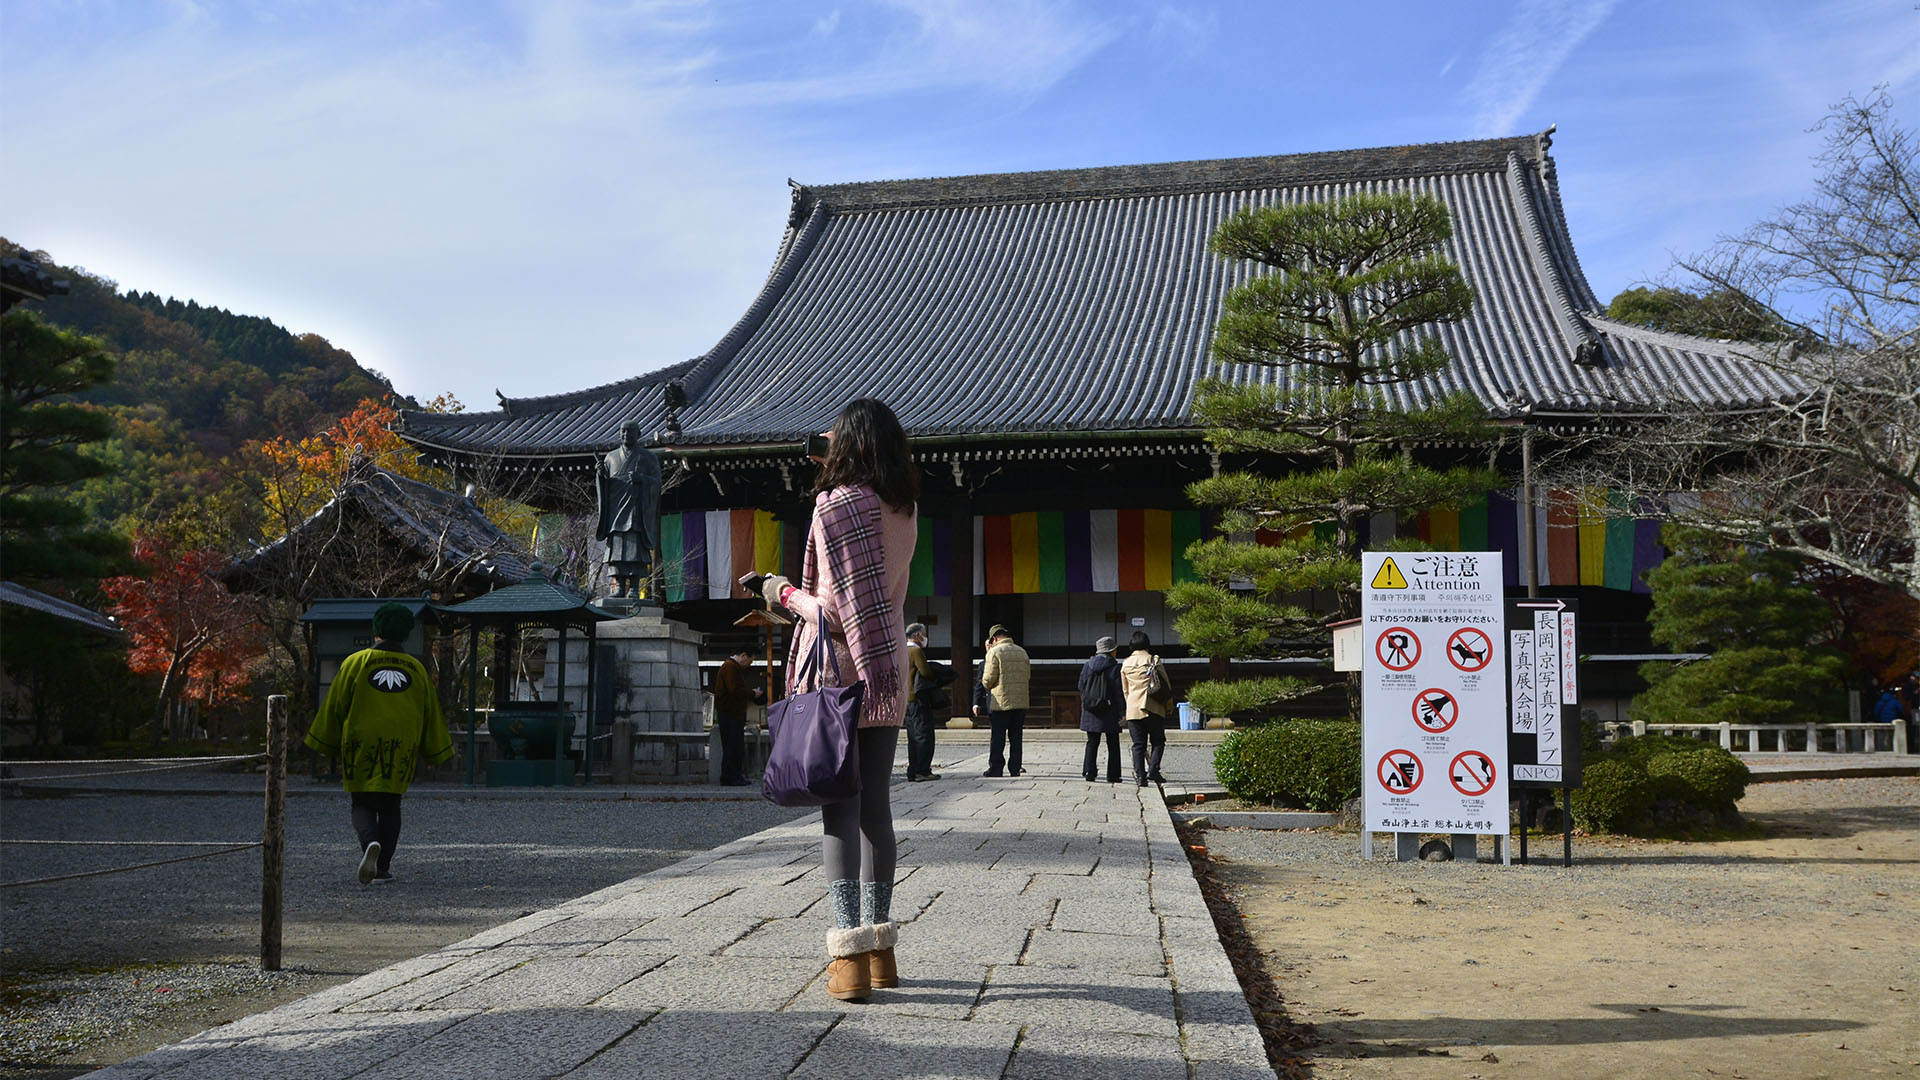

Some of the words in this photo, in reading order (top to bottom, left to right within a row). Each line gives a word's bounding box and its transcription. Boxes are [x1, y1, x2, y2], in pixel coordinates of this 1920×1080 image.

[1411, 555, 1479, 577] ご注意
[1411, 577, 1480, 590] Attention
[1369, 615, 1498, 624] 以下の5つのお願いをお守りください。
[1514, 632, 1535, 730] 写真展会場
[1537, 612, 1558, 763] 長岡京写真クラブ
[1516, 767, 1560, 780] (NPC)
[1381, 818, 1430, 829] 西山浄土宗
[1434, 820, 1494, 830] 総本山光明寺
